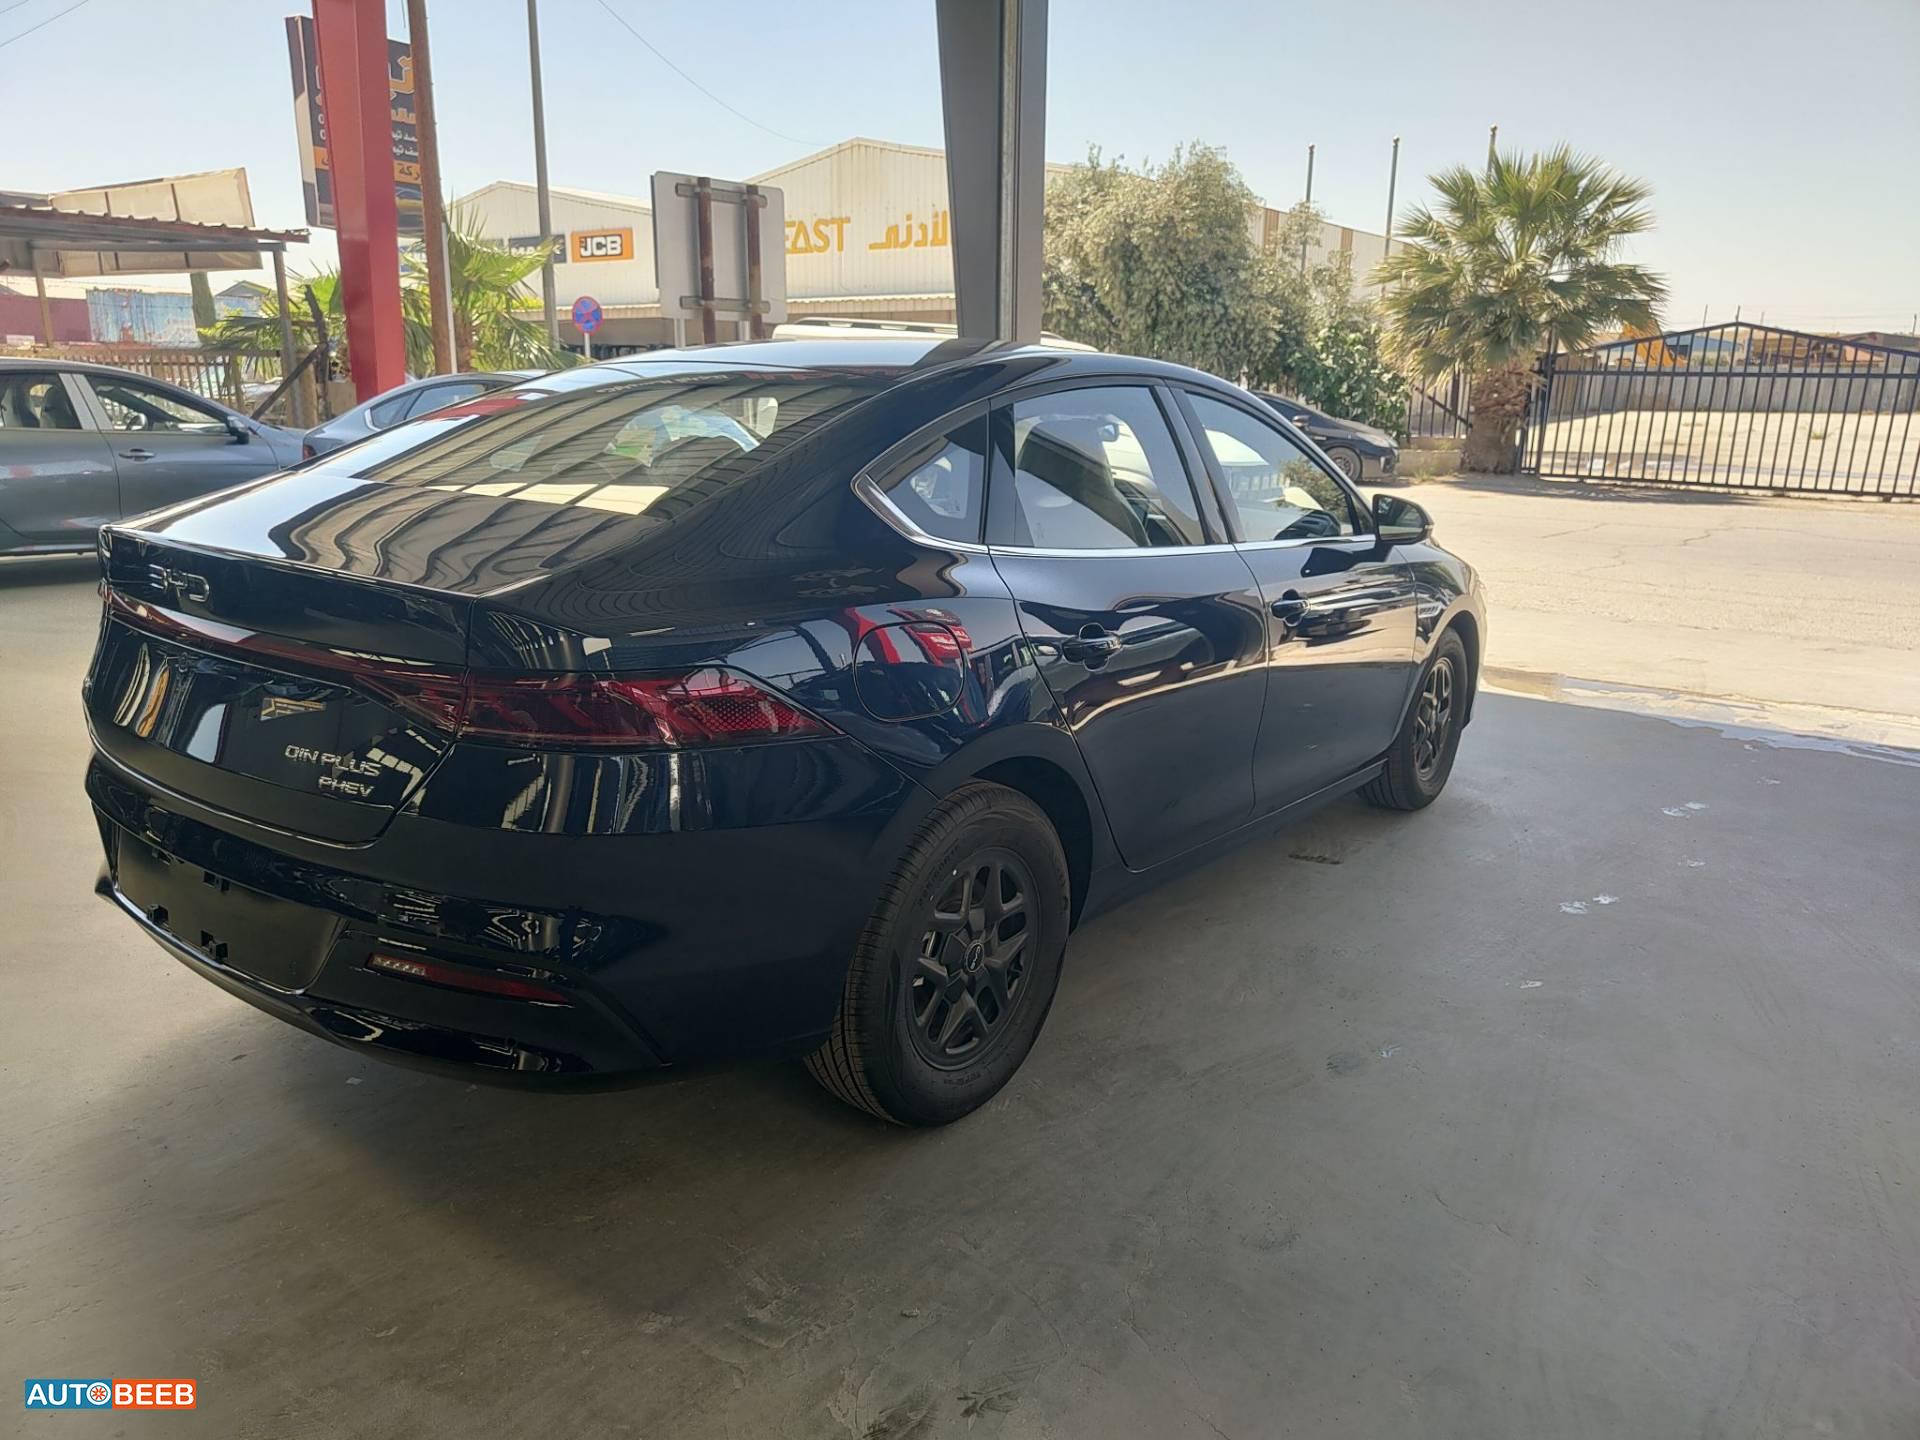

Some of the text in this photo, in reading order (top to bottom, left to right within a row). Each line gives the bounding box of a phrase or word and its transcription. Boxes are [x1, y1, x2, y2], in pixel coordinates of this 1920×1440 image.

[580, 235, 622, 257] JCB
[149, 564, 210, 602] BYD
[285, 745, 381, 777] QIN PLUS
[318, 776, 374, 797] PHEV
